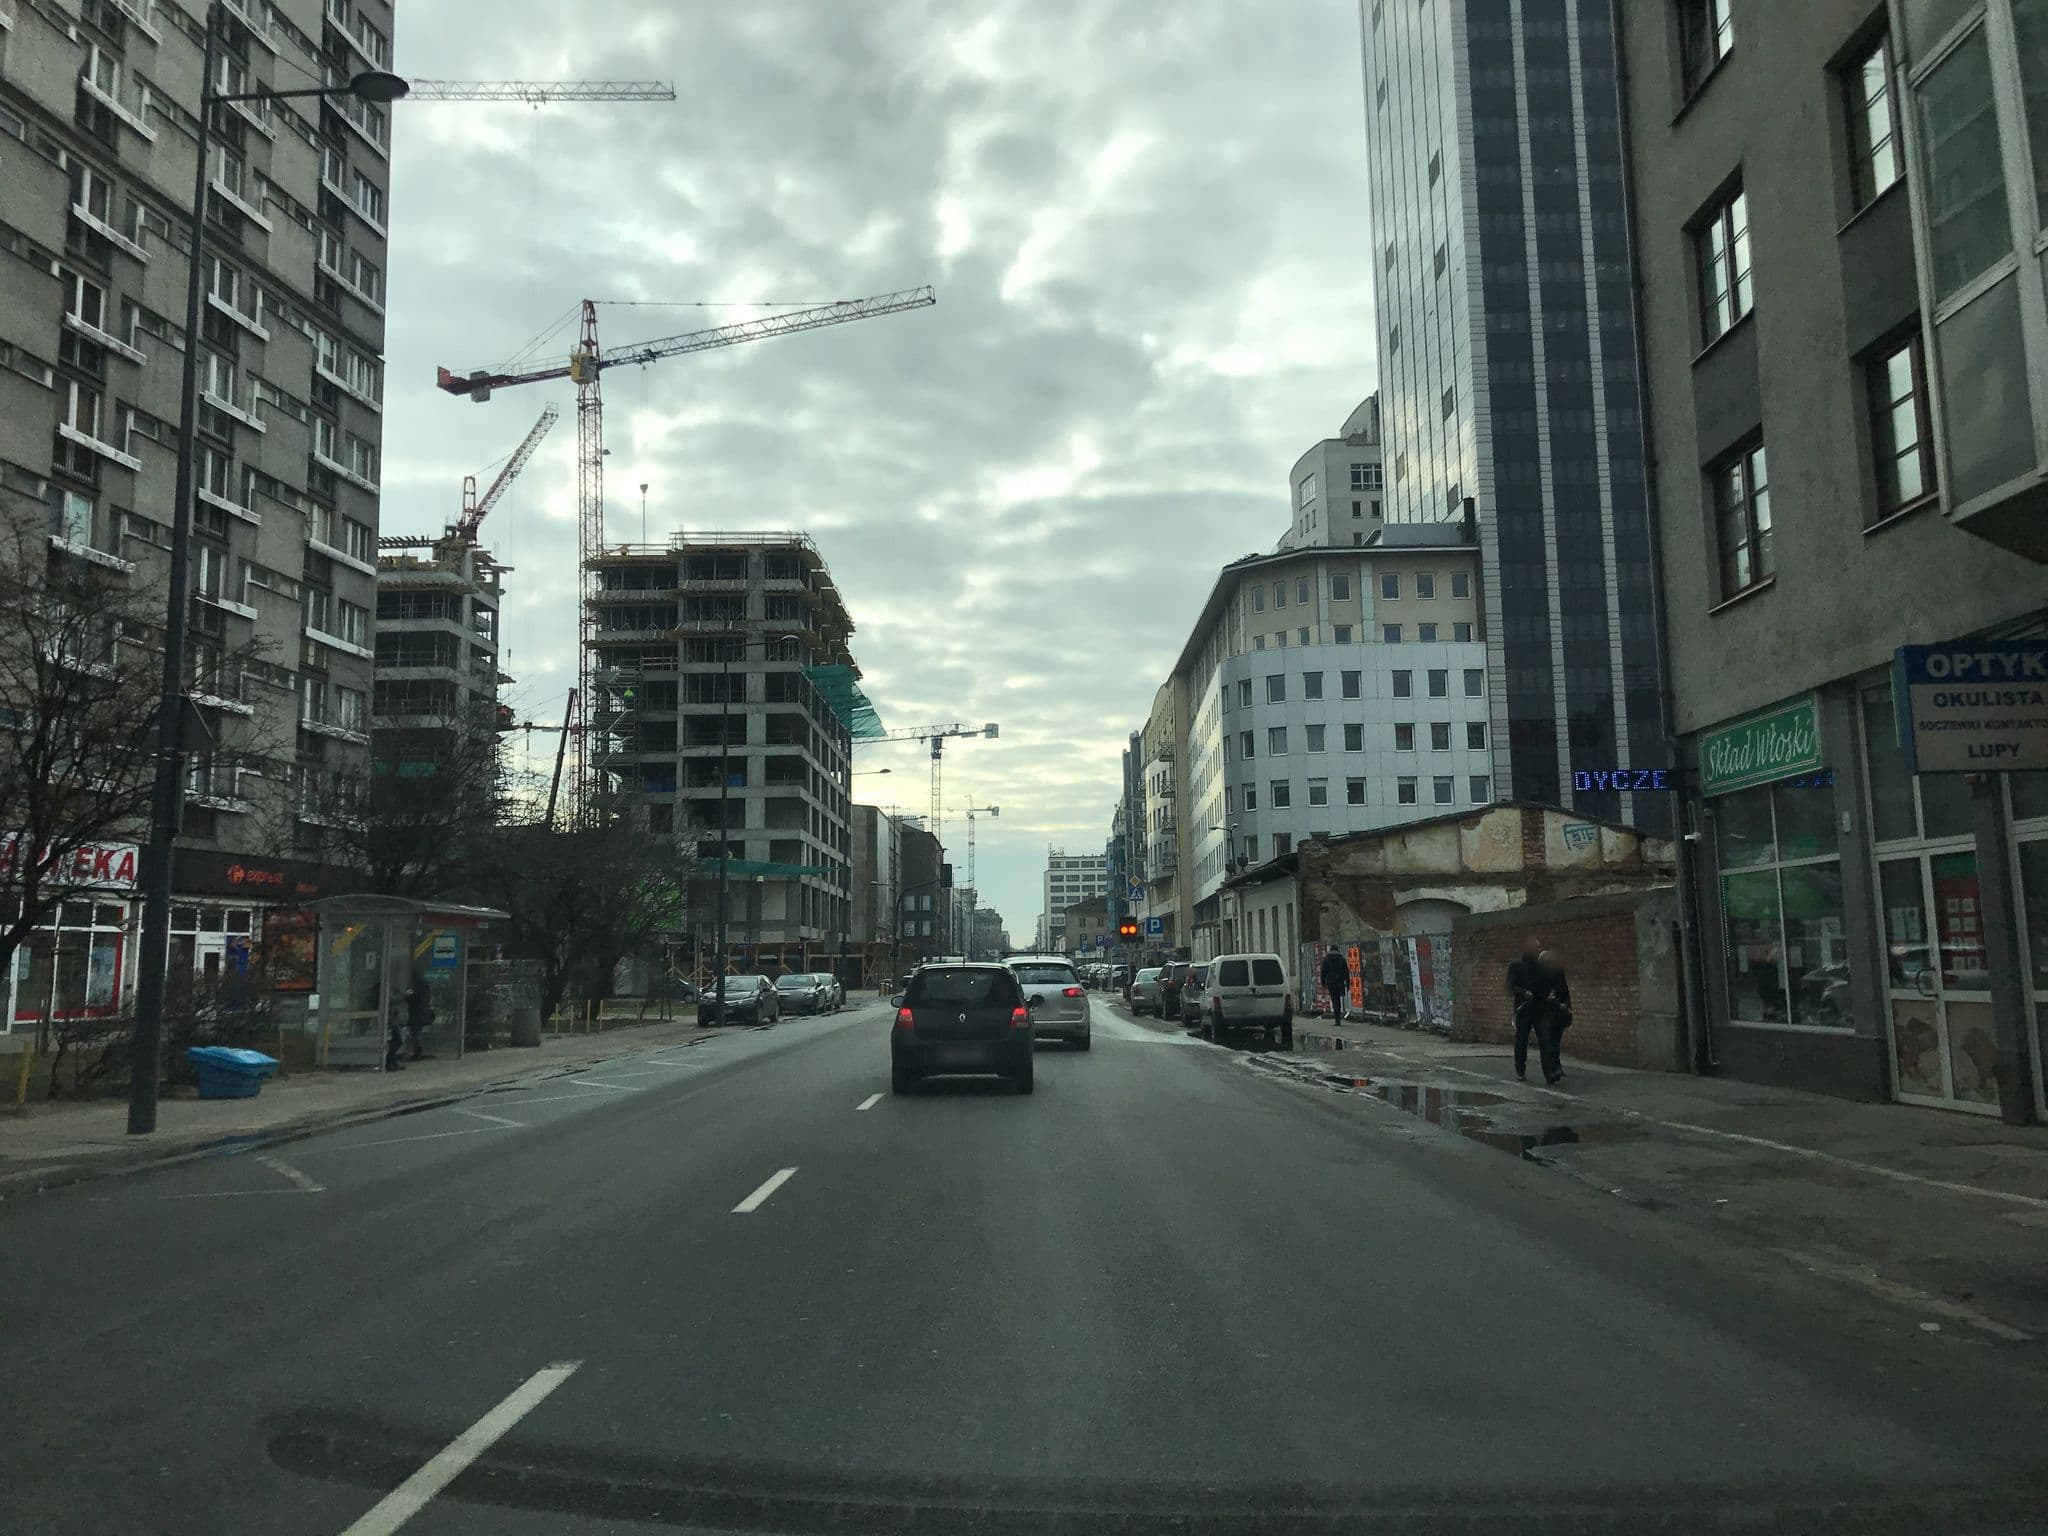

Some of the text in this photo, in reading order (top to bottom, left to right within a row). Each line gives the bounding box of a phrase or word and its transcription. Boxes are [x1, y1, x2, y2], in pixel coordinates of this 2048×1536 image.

[1926, 653, 2048, 678] OPTYK
[1934, 691, 2043, 707] OKULISTA
[1919, 719, 1981, 731] SOCZEWKI
[1707, 715, 1814, 781] Skład Włoski
[1968, 744, 2020, 758] LUPY
[1574, 770, 1669, 791] DYCZE
[1151, 919, 1160, 932] P
